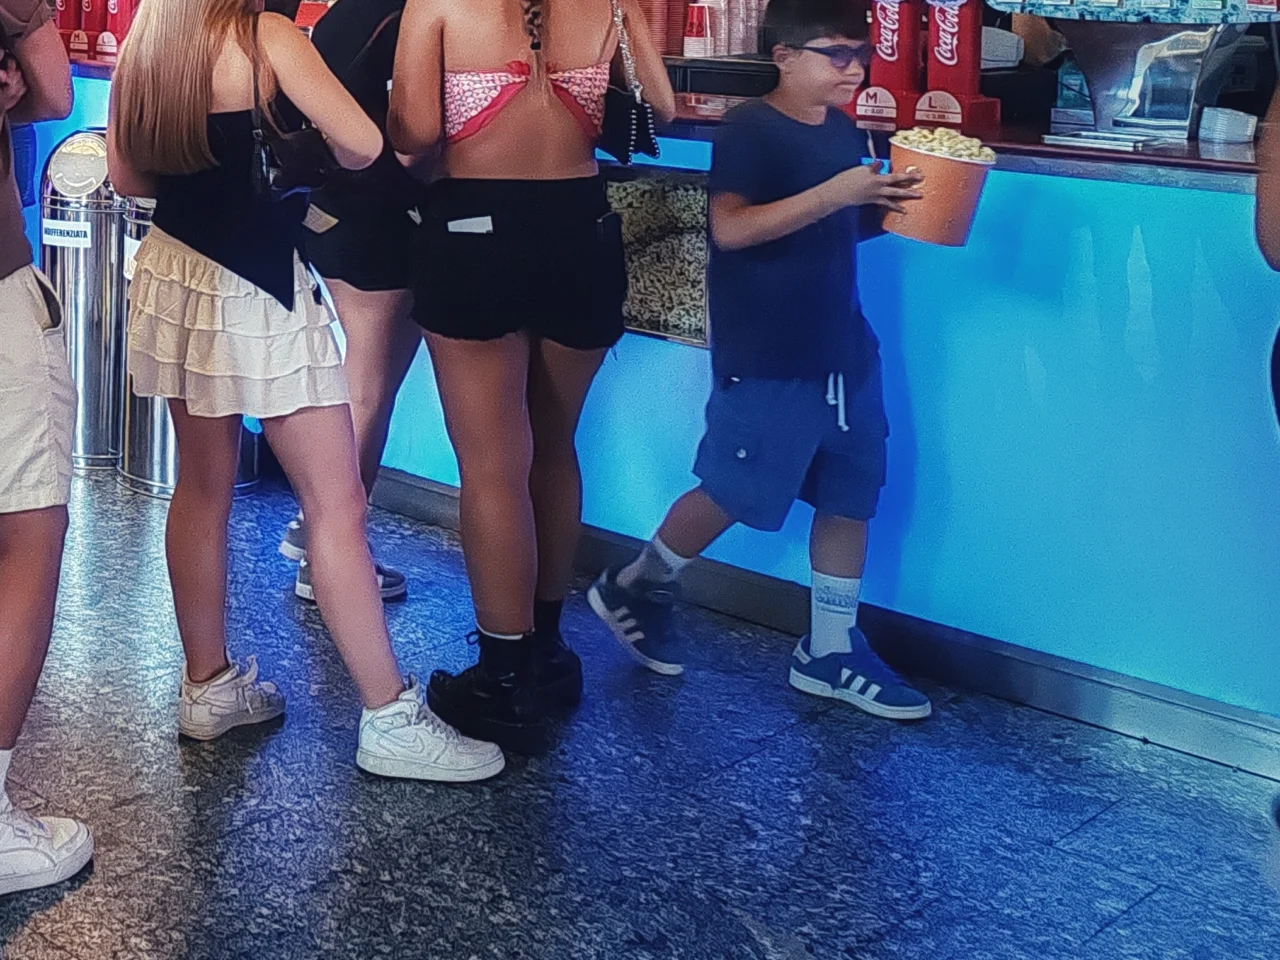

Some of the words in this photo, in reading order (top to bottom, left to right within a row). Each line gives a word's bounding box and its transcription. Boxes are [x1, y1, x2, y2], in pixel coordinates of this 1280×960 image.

[876, 1, 899, 62] Coca-Col
[934, 6, 959, 66] Coca-Col
[865, 91, 877, 104] M
[928, 96, 937, 109] L
